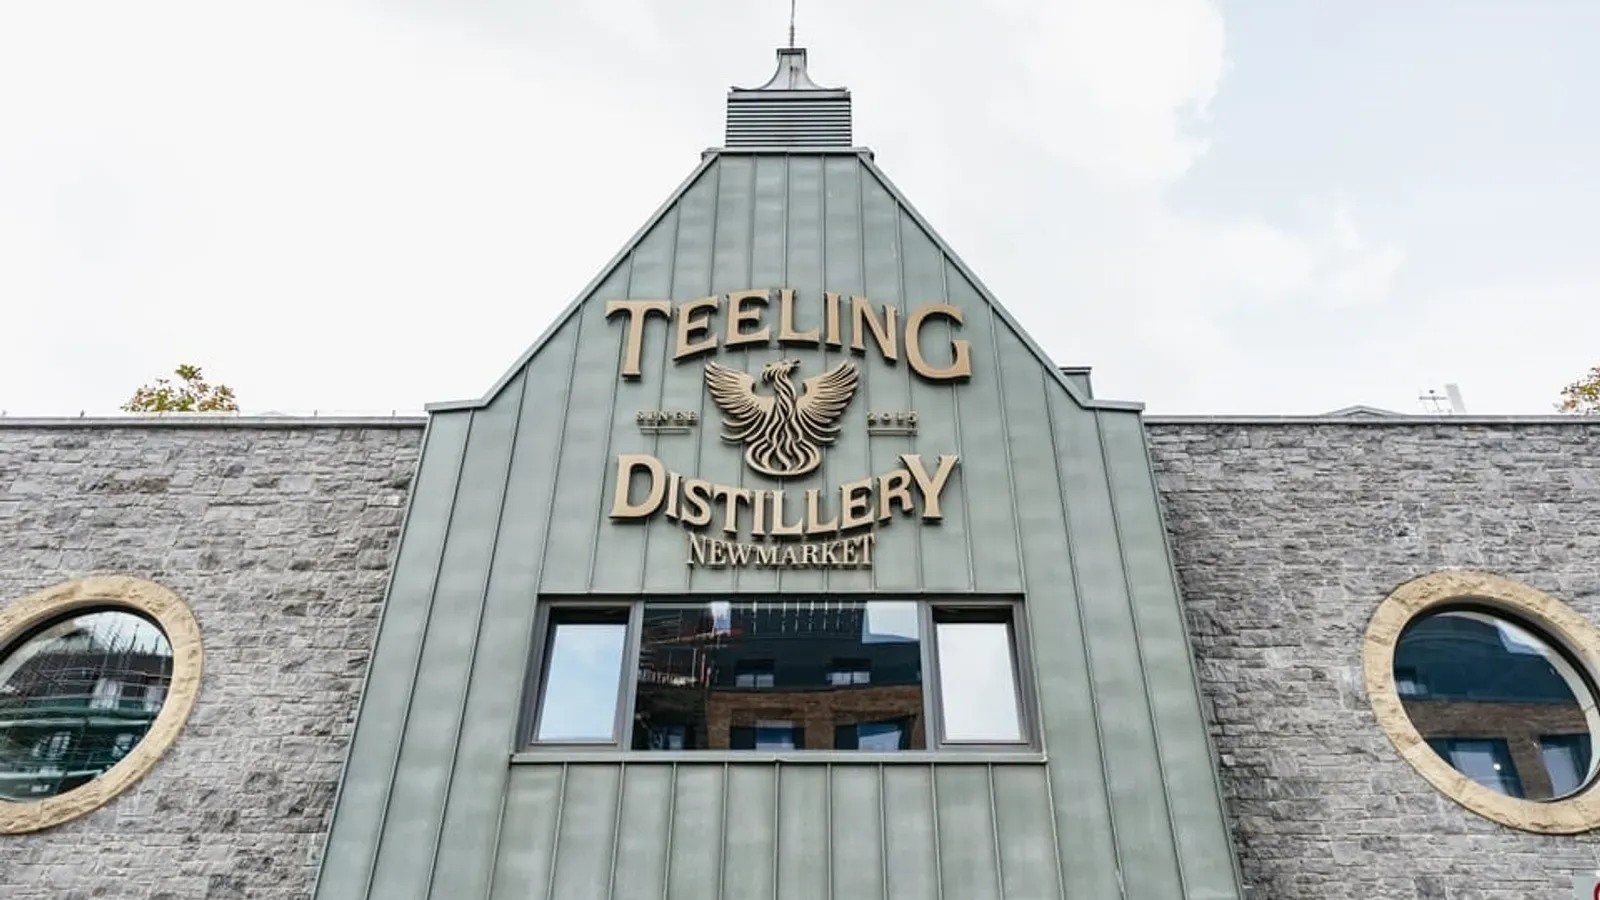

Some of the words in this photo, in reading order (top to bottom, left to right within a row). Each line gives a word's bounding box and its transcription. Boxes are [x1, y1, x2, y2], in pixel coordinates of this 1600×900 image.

[605, 288, 973, 382] TEELING
[608, 453, 960, 538] DISTILLERY
[686, 531, 876, 568] NEWMARKET
